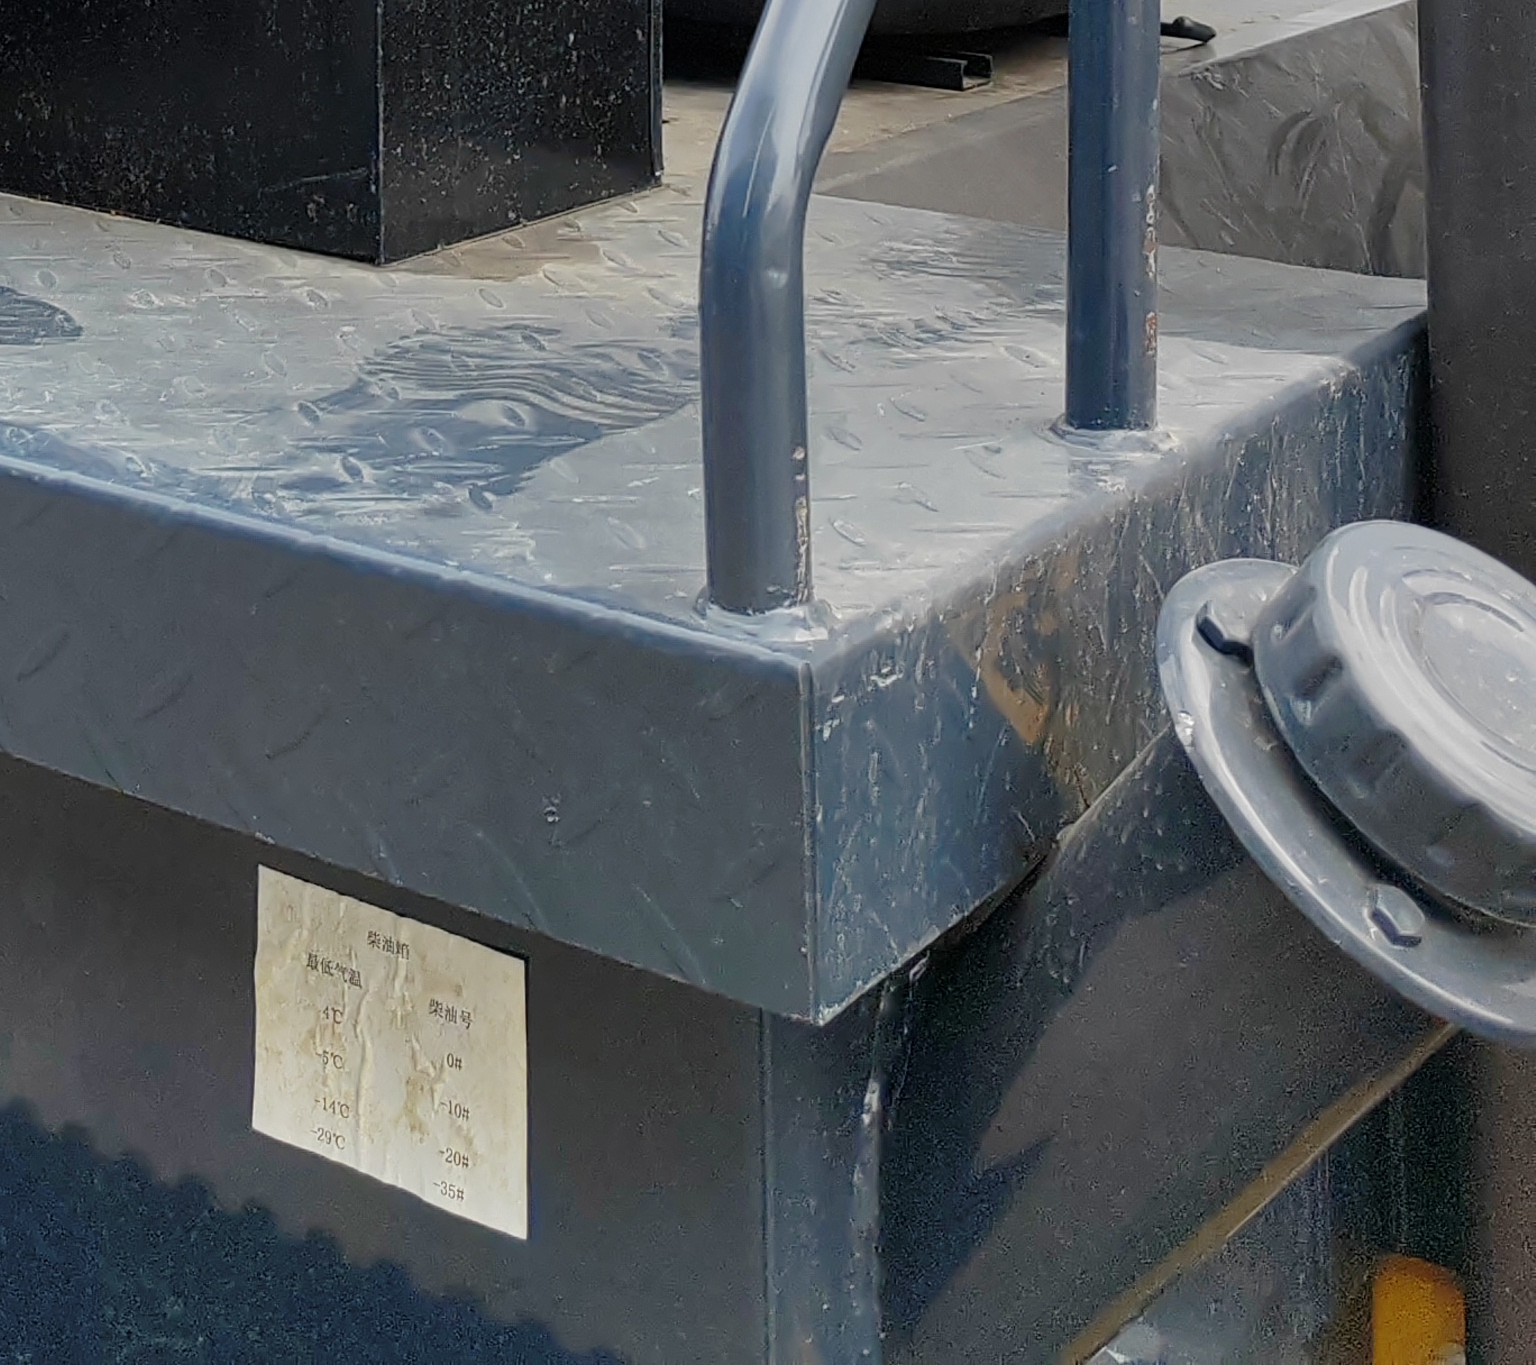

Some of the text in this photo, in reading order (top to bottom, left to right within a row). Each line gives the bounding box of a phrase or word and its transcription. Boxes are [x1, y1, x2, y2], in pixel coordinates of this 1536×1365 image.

[306, 952, 362, 989] 最低气温
[428, 998, 473, 1029] 柴油号
[446, 1052, 462, 1071] 0#
[440, 1099, 469, 1121] -10#
[439, 1147, 469, 1168] -20#
[433, 1180, 464, 1202] -35#
